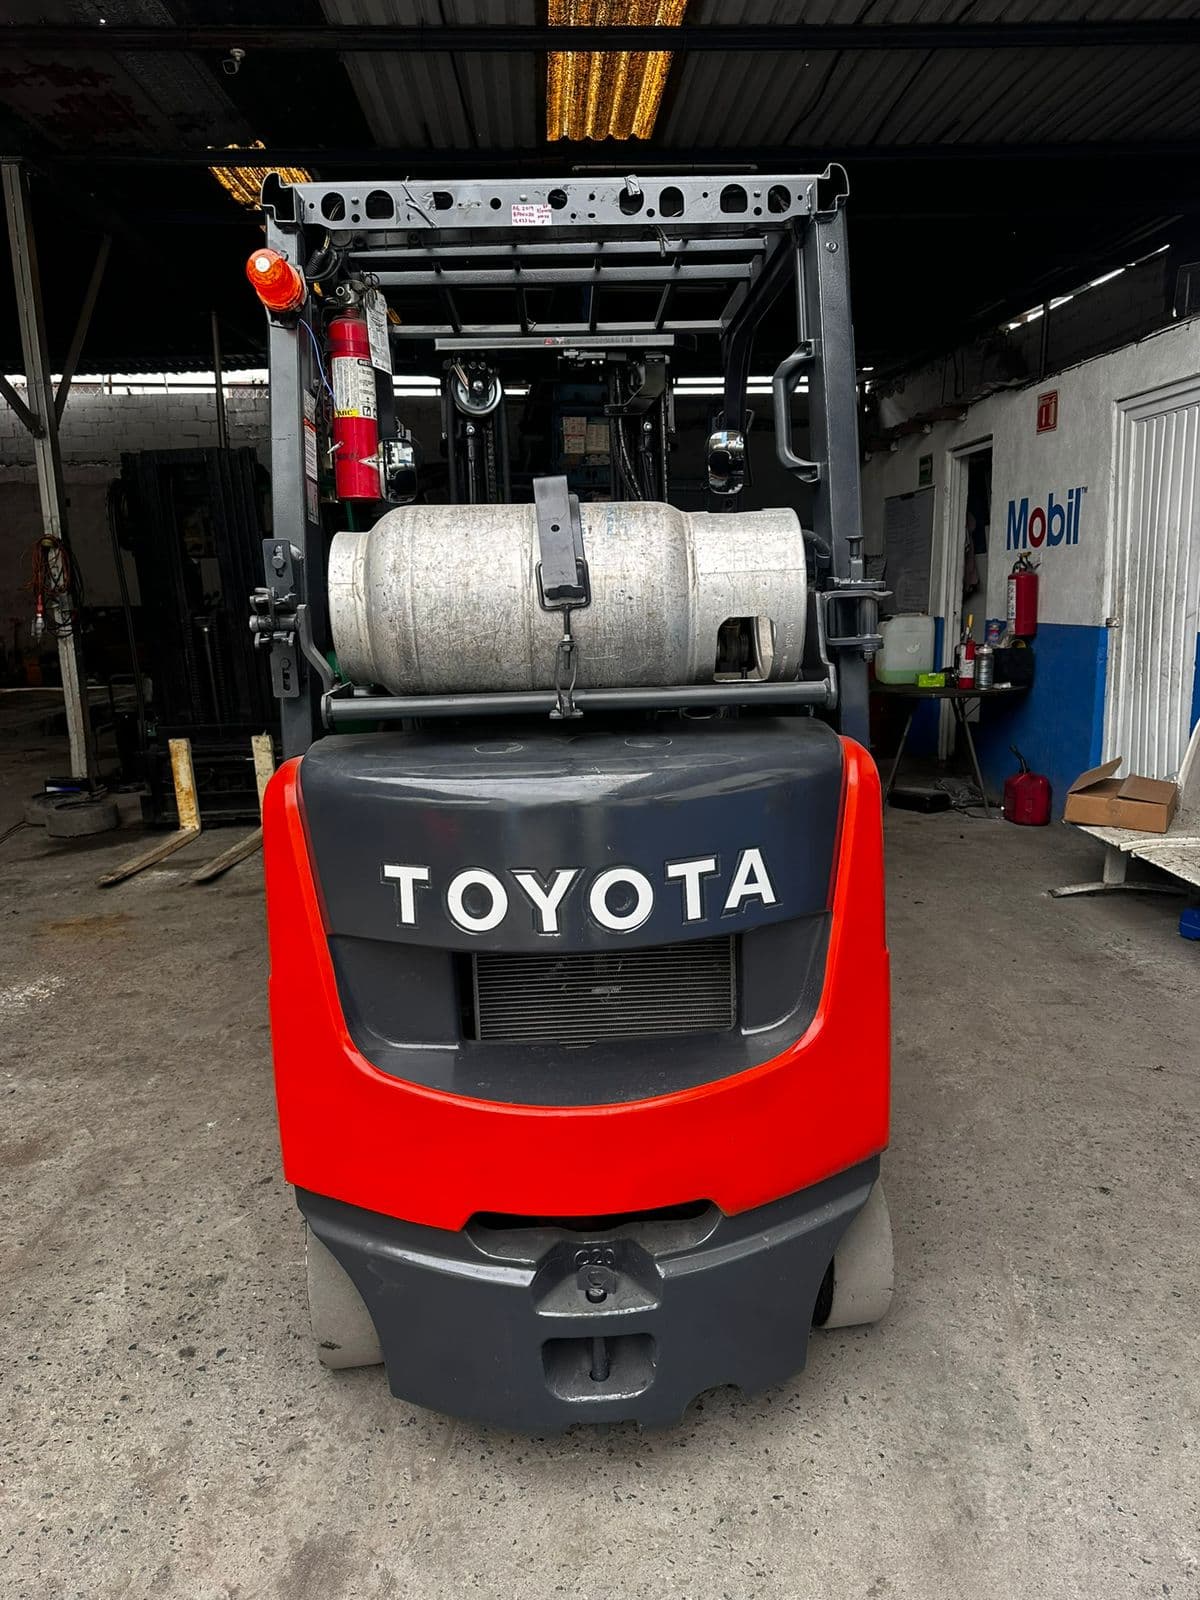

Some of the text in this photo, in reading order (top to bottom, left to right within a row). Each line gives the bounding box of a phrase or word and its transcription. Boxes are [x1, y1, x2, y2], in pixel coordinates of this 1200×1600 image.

[1006, 487, 1082, 551] Mobil
[382, 847, 777, 934] TOYOTA
[573, 1247, 615, 1265] C20
